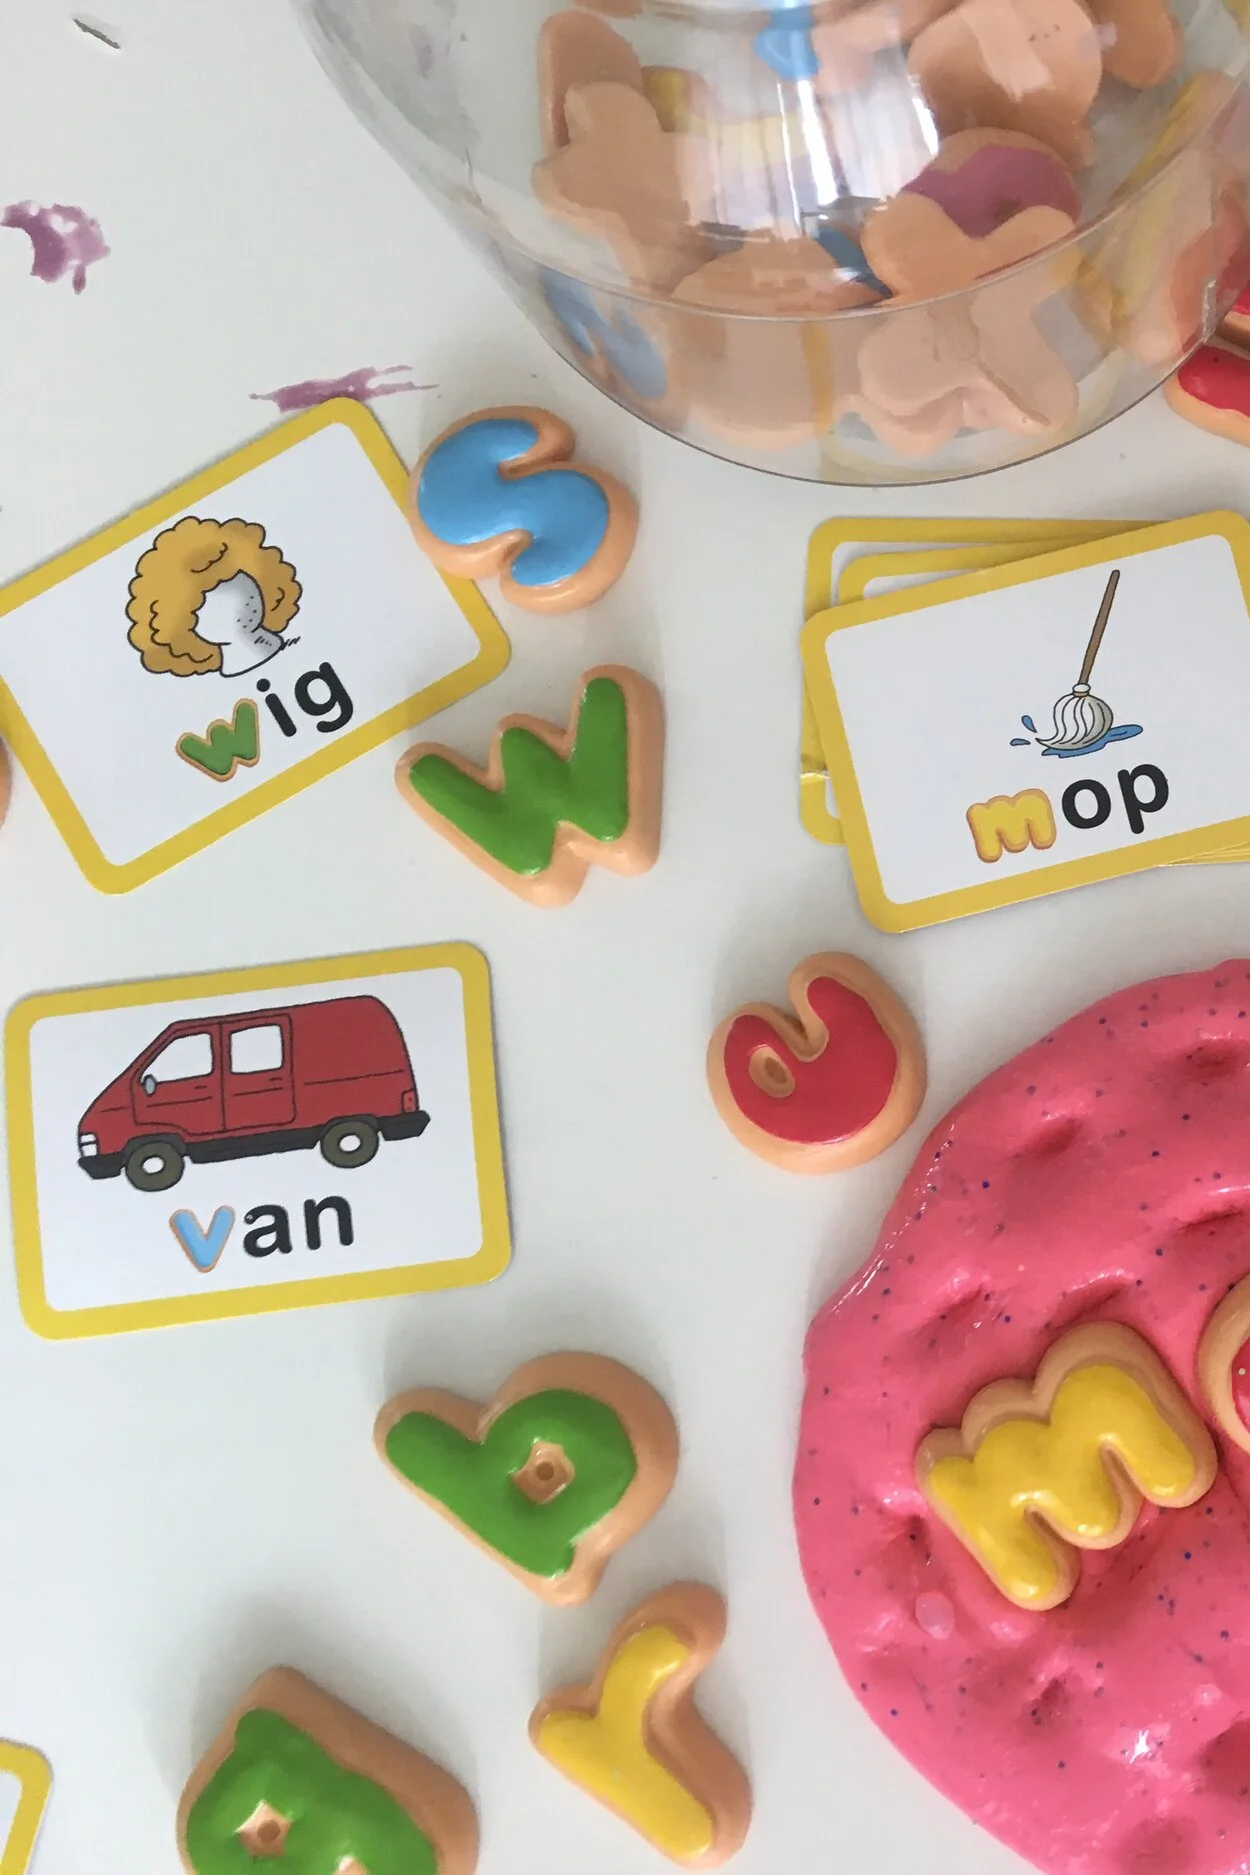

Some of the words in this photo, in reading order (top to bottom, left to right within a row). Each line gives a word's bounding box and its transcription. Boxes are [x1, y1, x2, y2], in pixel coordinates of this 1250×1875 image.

[175, 661, 354, 783] wig
[966, 763, 1169, 864] mop
[168, 1194, 356, 1274] van
